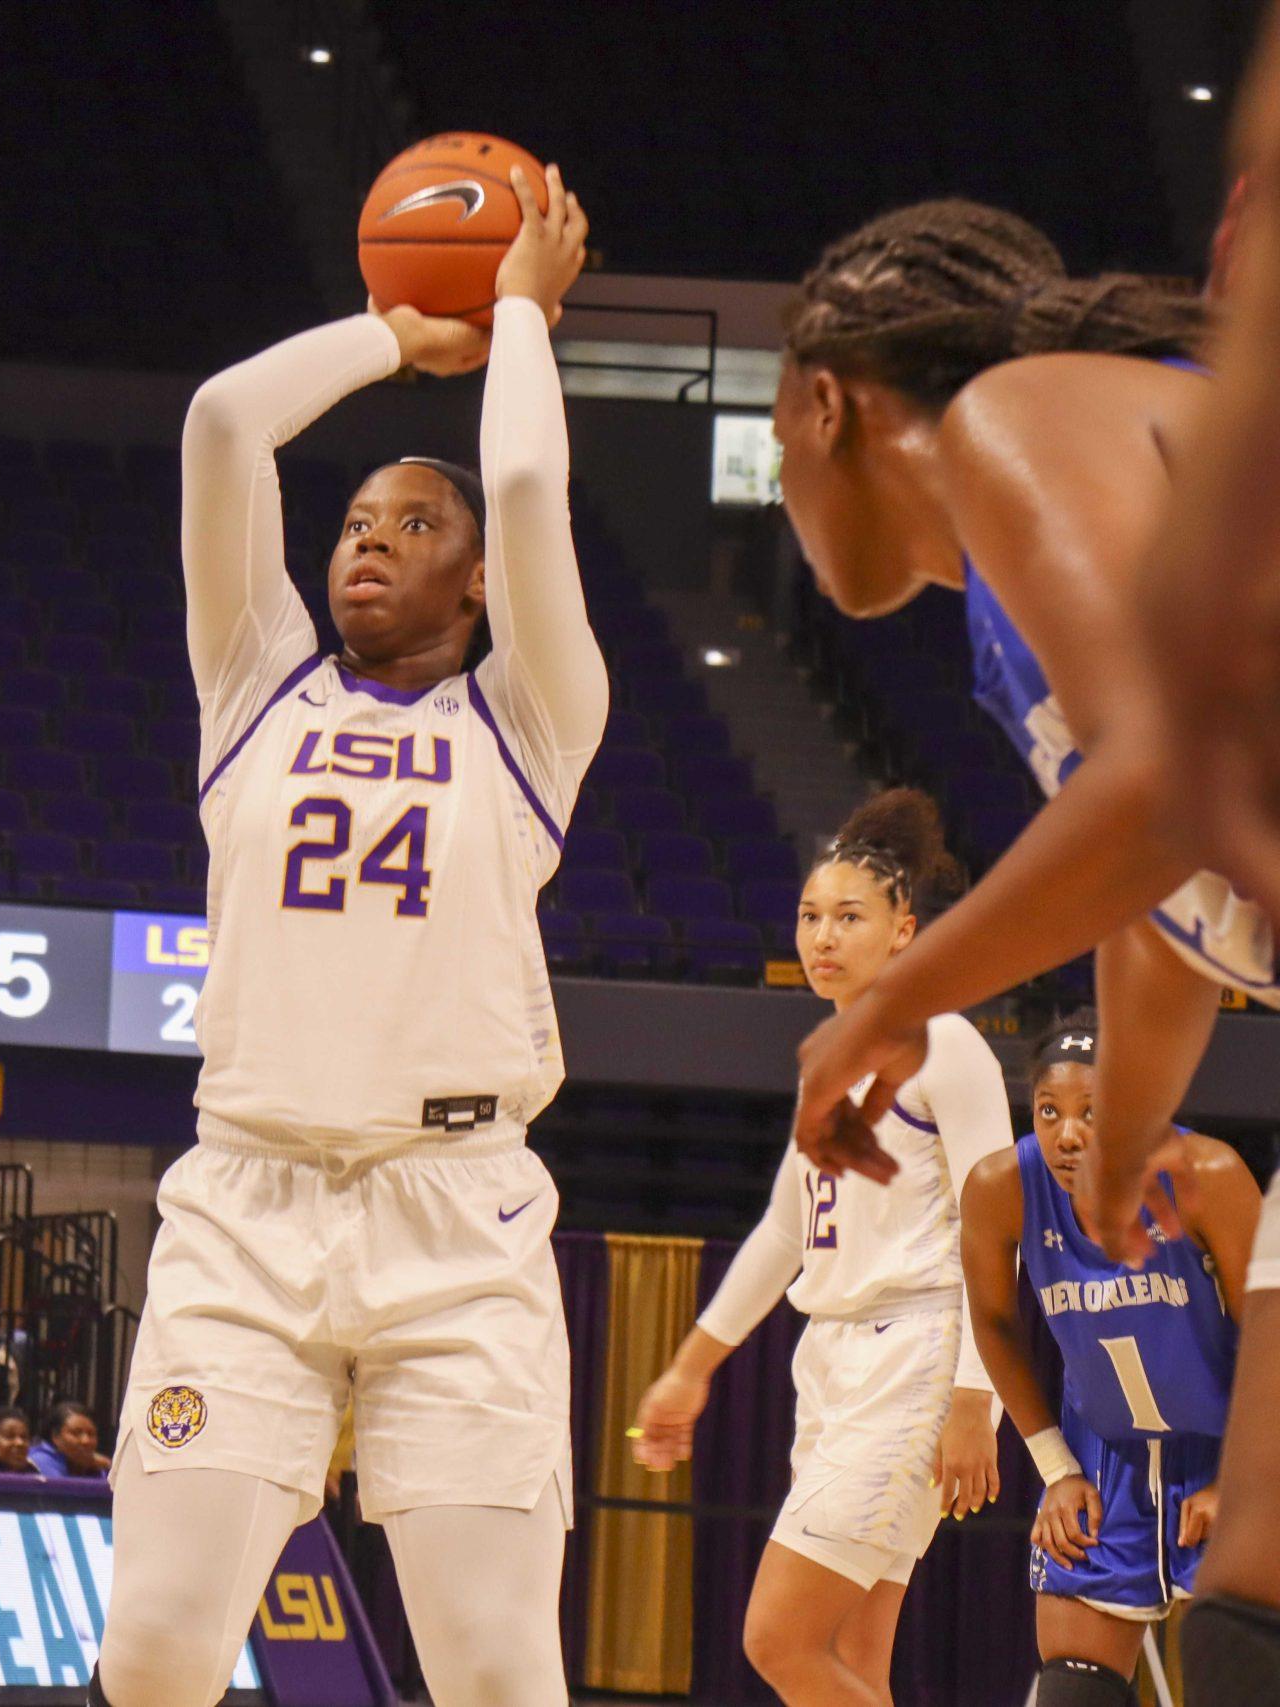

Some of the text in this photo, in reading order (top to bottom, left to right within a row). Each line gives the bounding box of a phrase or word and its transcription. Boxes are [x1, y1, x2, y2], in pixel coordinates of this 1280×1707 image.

[289, 729, 453, 785] LSU
[280, 793, 433, 920] 24
[804, 1171, 838, 1250] 12
[1097, 1335, 1172, 1433] 1
[258, 1573, 347, 1642] LSU
